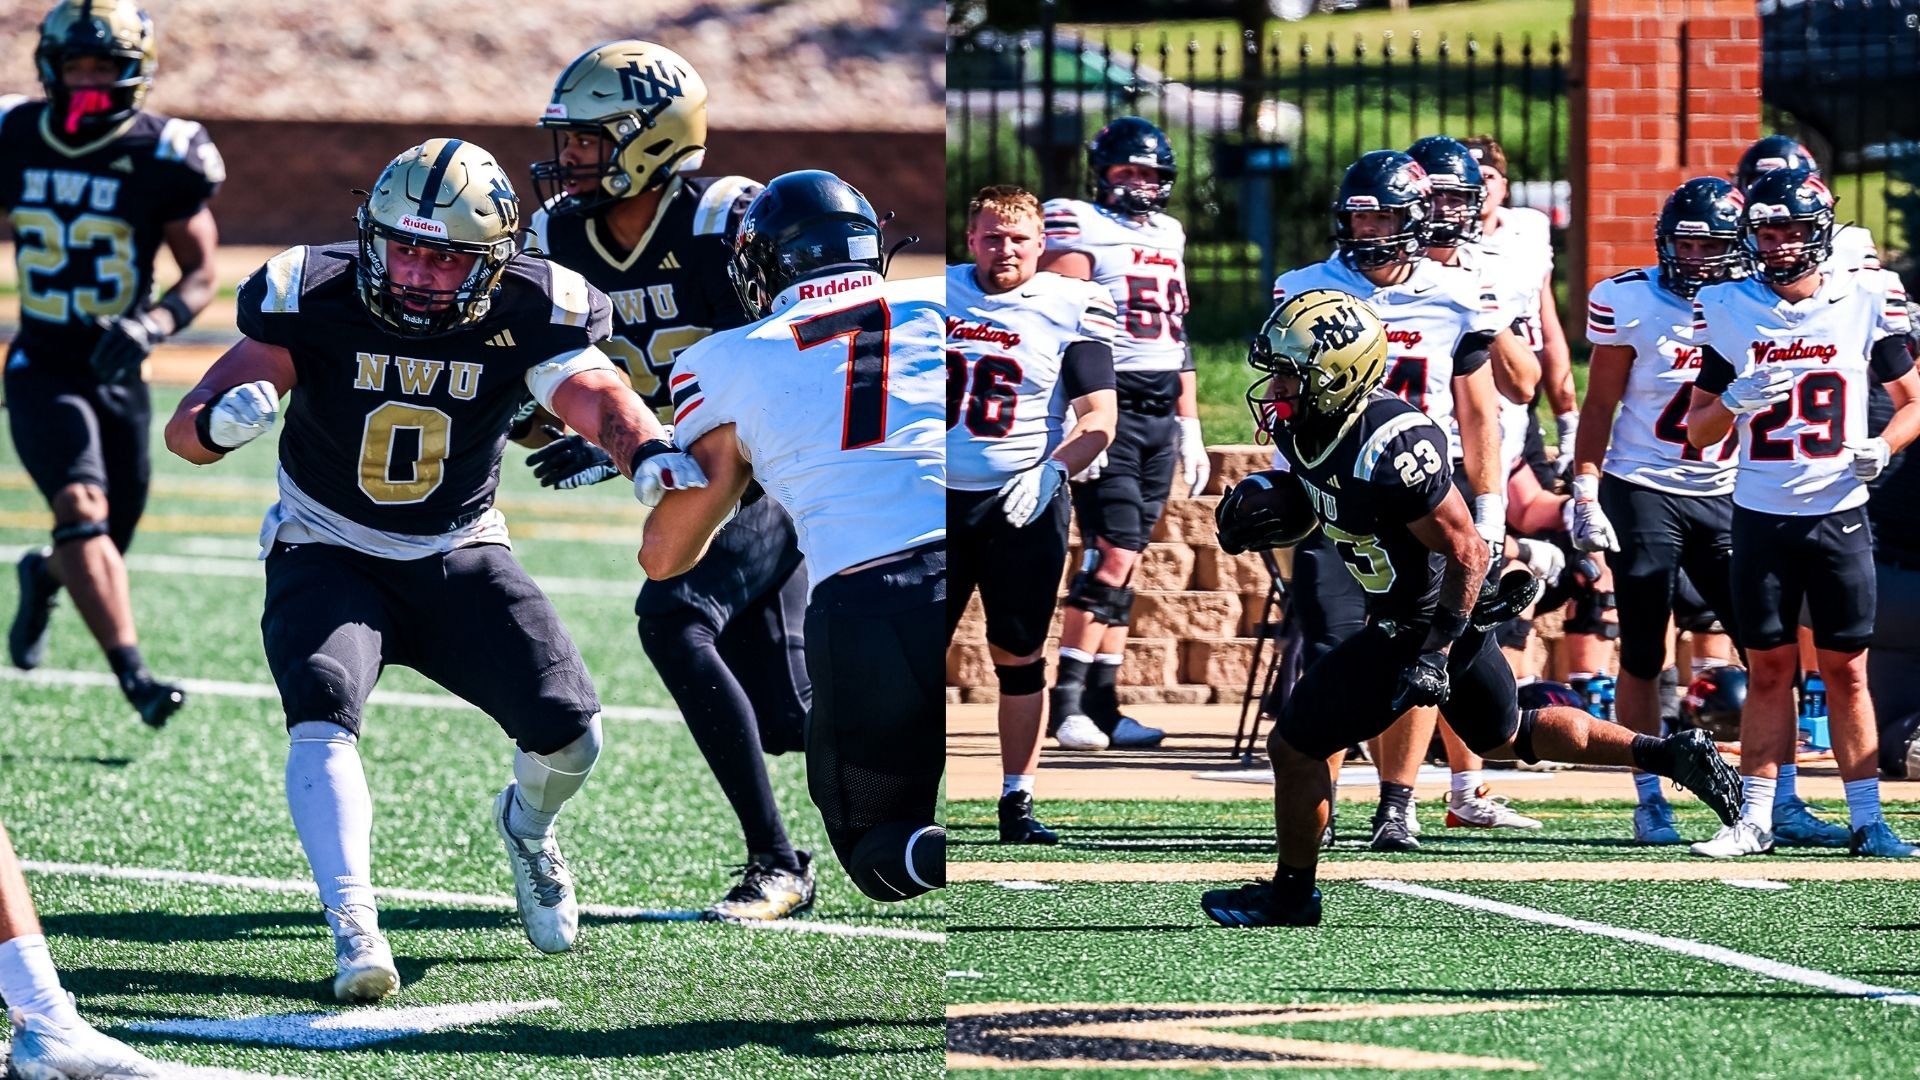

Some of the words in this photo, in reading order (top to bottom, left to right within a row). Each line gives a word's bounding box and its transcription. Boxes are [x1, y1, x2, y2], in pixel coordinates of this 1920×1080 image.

[22, 169, 120, 209] NWU
[402, 216, 442, 234] Riddell
[9, 206, 139, 324] 23
[800, 275, 873, 301] Riddell
[353, 351, 484, 401] NWU
[789, 297, 891, 451] 7
[1750, 338, 1838, 365] Wartburg
[1654, 380, 1742, 463] 4
[1749, 370, 1847, 461] 29
[357, 400, 453, 505] 0
[1394, 439, 1443, 488] 23
